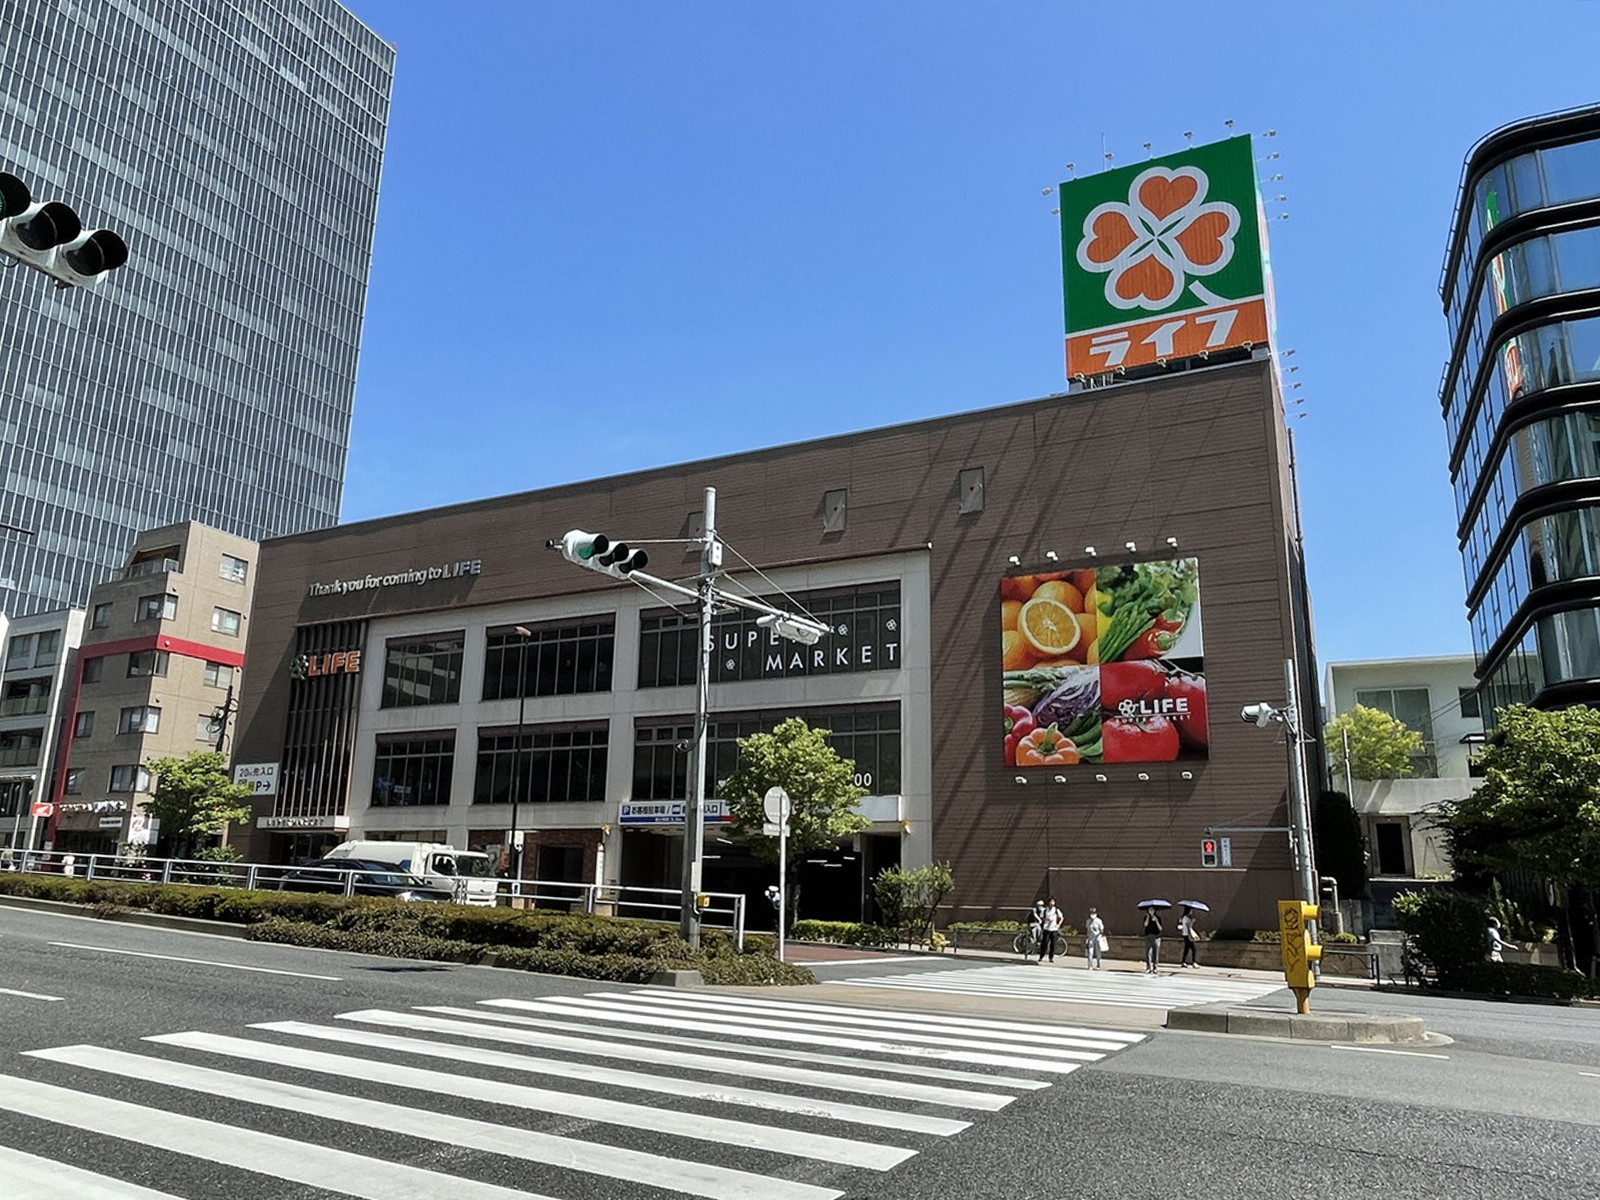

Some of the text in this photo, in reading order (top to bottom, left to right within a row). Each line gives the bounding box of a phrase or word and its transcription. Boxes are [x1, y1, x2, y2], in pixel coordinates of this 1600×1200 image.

[1090, 309, 1239, 367] ライフ
[309, 559, 481, 596] Thank you for coming to LIFE
[707, 630, 780, 652] SUPE
[308, 650, 361, 676] LIFE
[765, 643, 898, 671] MARKET
[1140, 698, 1188, 714] LIFE
